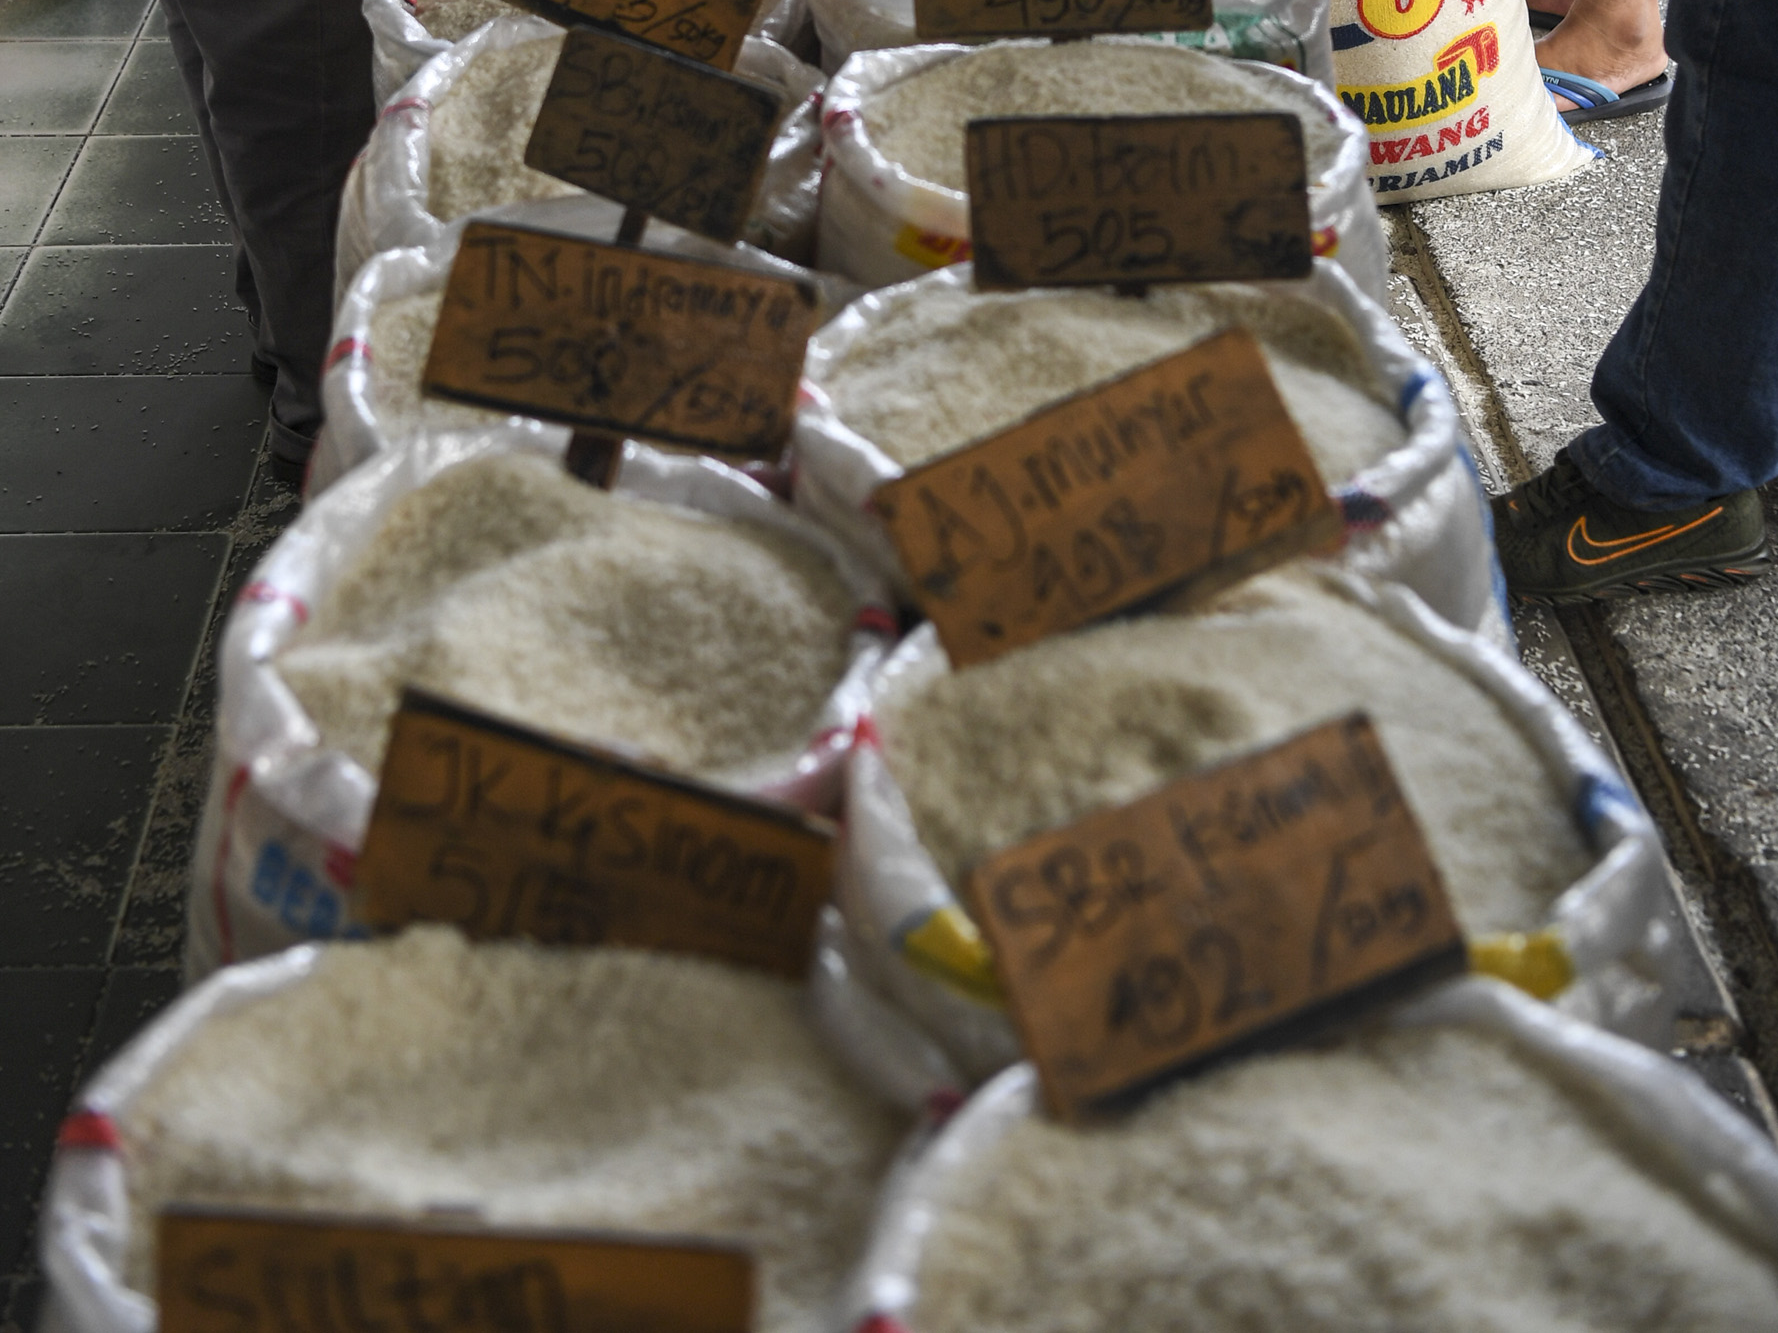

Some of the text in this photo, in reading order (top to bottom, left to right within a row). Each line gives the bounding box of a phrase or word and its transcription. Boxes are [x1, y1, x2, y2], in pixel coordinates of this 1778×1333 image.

[1341, 58, 1475, 125] MAULANA
[1368, 104, 1490, 165] WANG
[1369, 129, 1505, 193] RJAMIN
